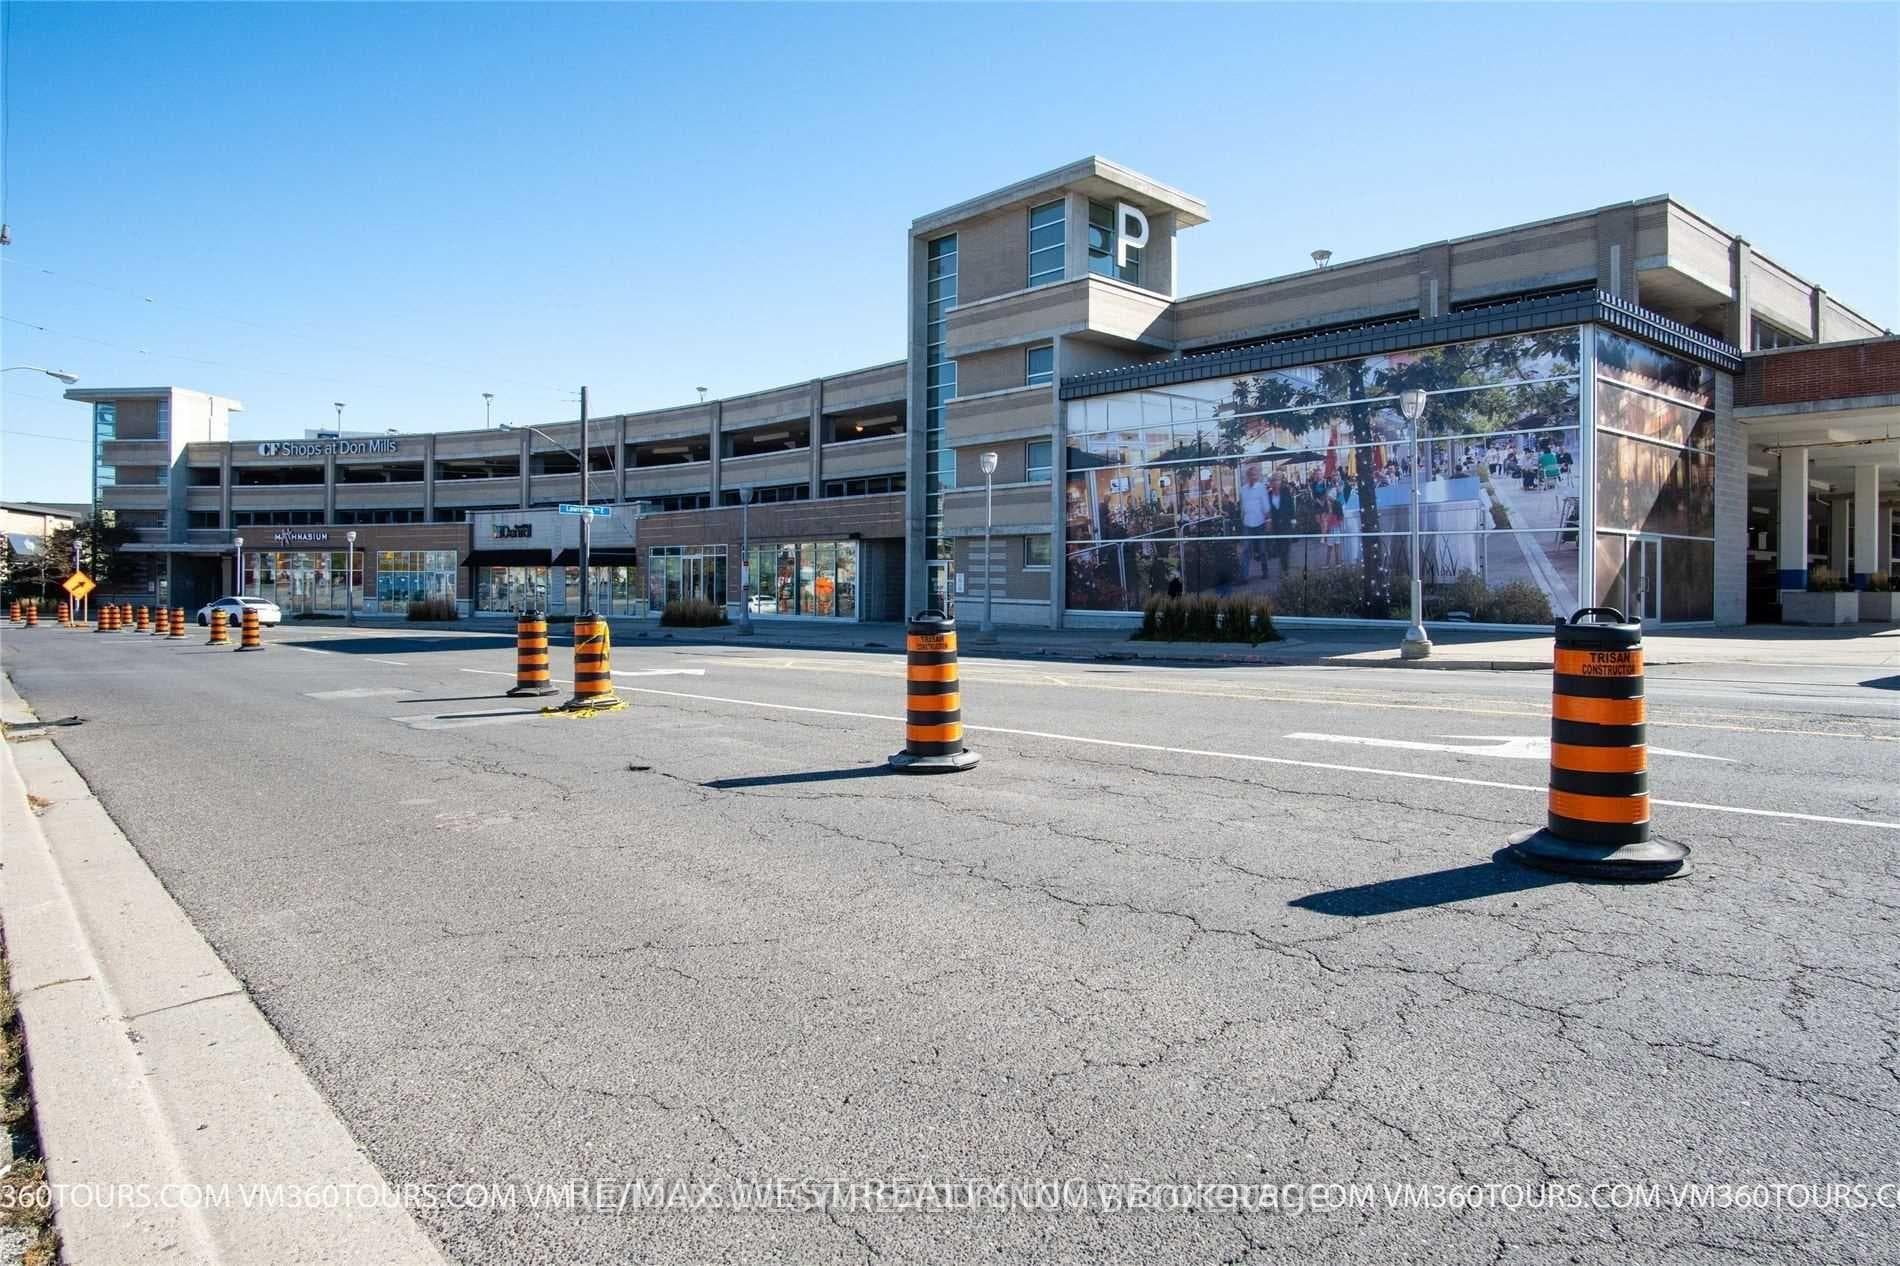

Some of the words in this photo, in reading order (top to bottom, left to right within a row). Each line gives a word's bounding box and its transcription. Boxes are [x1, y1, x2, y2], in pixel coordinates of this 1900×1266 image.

[1117, 202, 1149, 268] P
[257, 442, 280, 456] CF
[282, 442, 320, 459] Shops
[324, 443, 337, 455] at
[340, 440, 366, 454] Don
[369, 439, 397, 453] Mills
[1590, 652, 1631, 663] TRISAN
[1582, 664, 1636, 676] CONSTRUCTION
